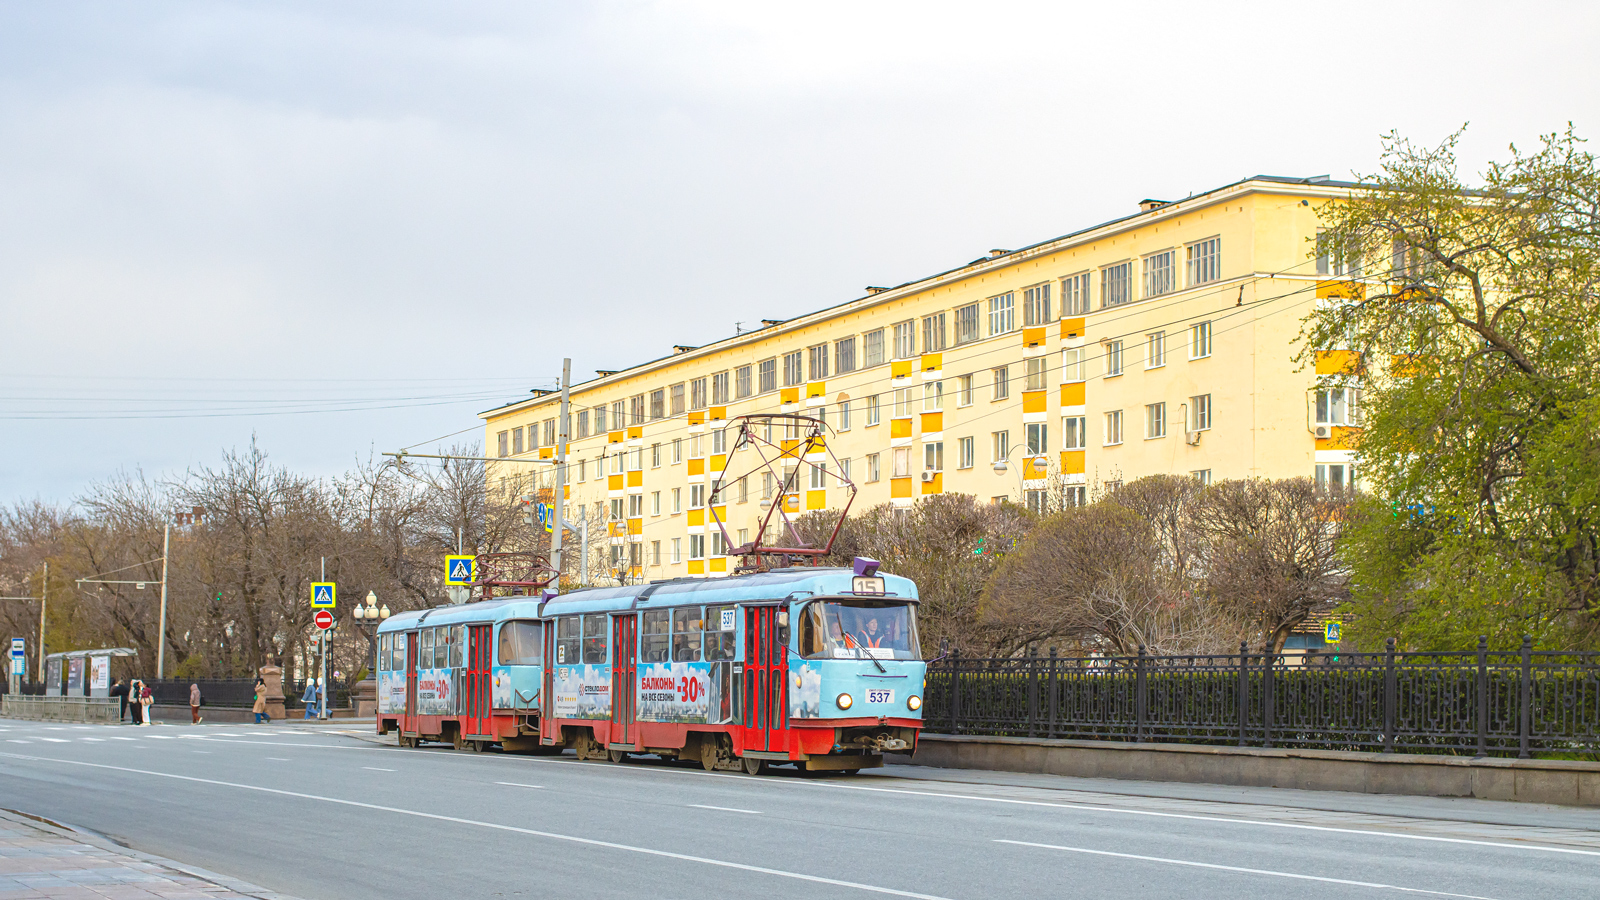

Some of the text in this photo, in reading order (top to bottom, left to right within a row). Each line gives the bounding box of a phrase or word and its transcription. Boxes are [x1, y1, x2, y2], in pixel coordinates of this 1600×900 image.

[858, 581, 876, 595] 15
[723, 612, 733, 624] 537
[641, 677, 675, 690] БАЛКОНЫ
[677, 676, 705, 702] -30%
[641, 693, 675, 701] НА ВСЕ СЕЗОНЫ
[870, 692, 890, 702] 537
